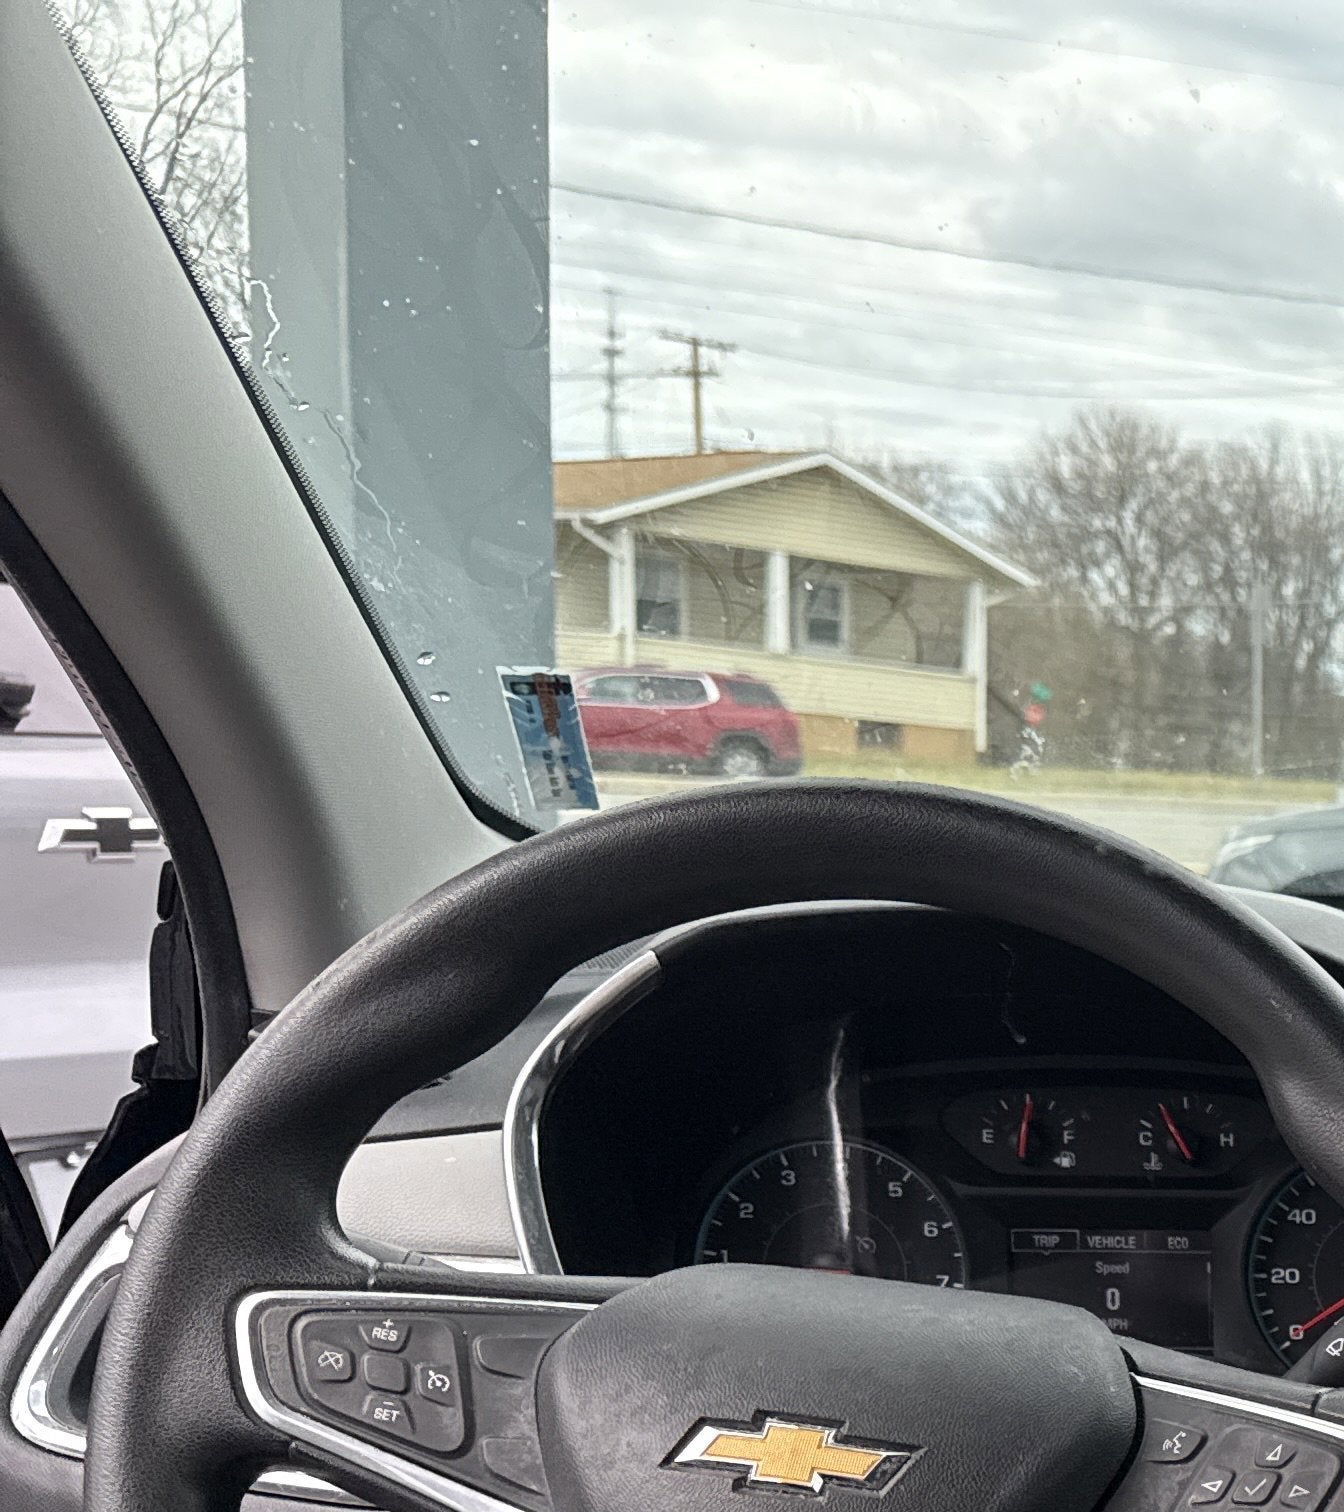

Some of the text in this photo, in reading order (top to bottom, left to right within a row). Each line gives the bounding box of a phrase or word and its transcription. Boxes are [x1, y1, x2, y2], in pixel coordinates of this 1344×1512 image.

[981, 1129, 996, 1144] E
[1062, 1130, 1076, 1145] F
[1138, 1131, 1154, 1147] C
[1219, 1133, 1235, 1149] H
[780, 1169, 797, 1187] 3
[887, 1181, 904, 1199] 5
[738, 1202, 755, 1220] 2
[1286, 1208, 1317, 1226] 40
[922, 1221, 940, 1238] 6
[1031, 1233, 1062, 1249] TRIP
[1086, 1234, 1138, 1250] VEHICLE
[1166, 1235, 1190, 1251] ECO
[1094, 1260, 1131, 1276] Speed
[1270, 1267, 1301, 1285] 20
[1104, 1286, 1121, 1312] 0
[371, 1326, 399, 1342] RES
[373, 1407, 401, 1423] SET
